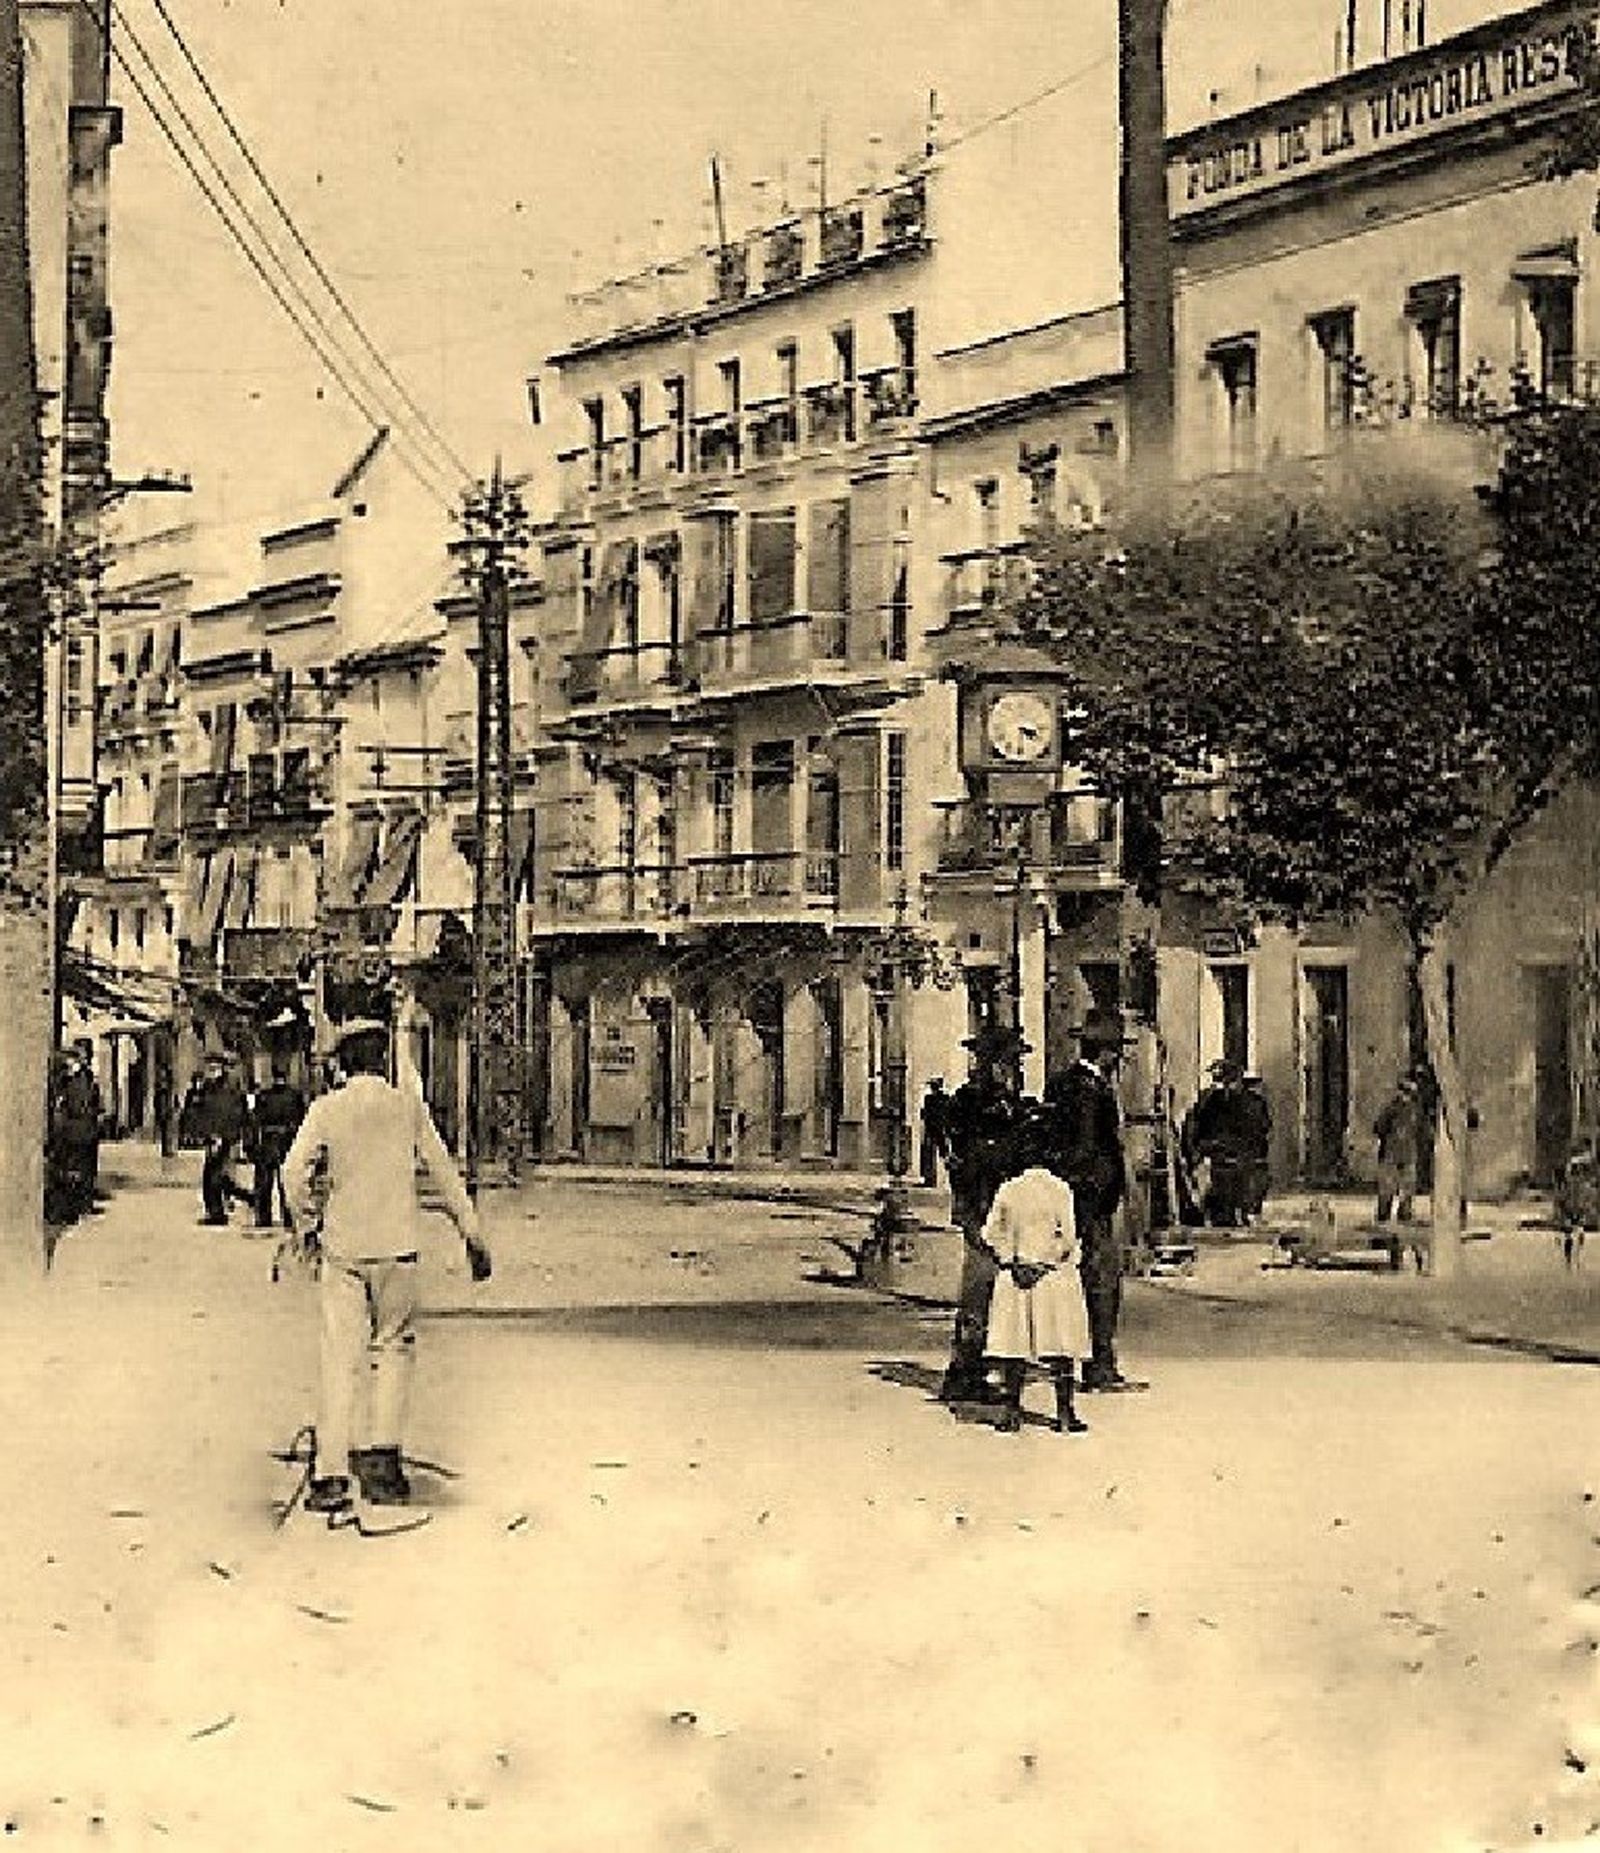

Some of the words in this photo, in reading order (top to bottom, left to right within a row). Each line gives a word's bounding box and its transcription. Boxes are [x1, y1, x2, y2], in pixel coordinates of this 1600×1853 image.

[1278, 119, 1310, 170] DE
[1322, 100, 1355, 156] LA
[1367, 54, 1493, 139] VICTORIA
